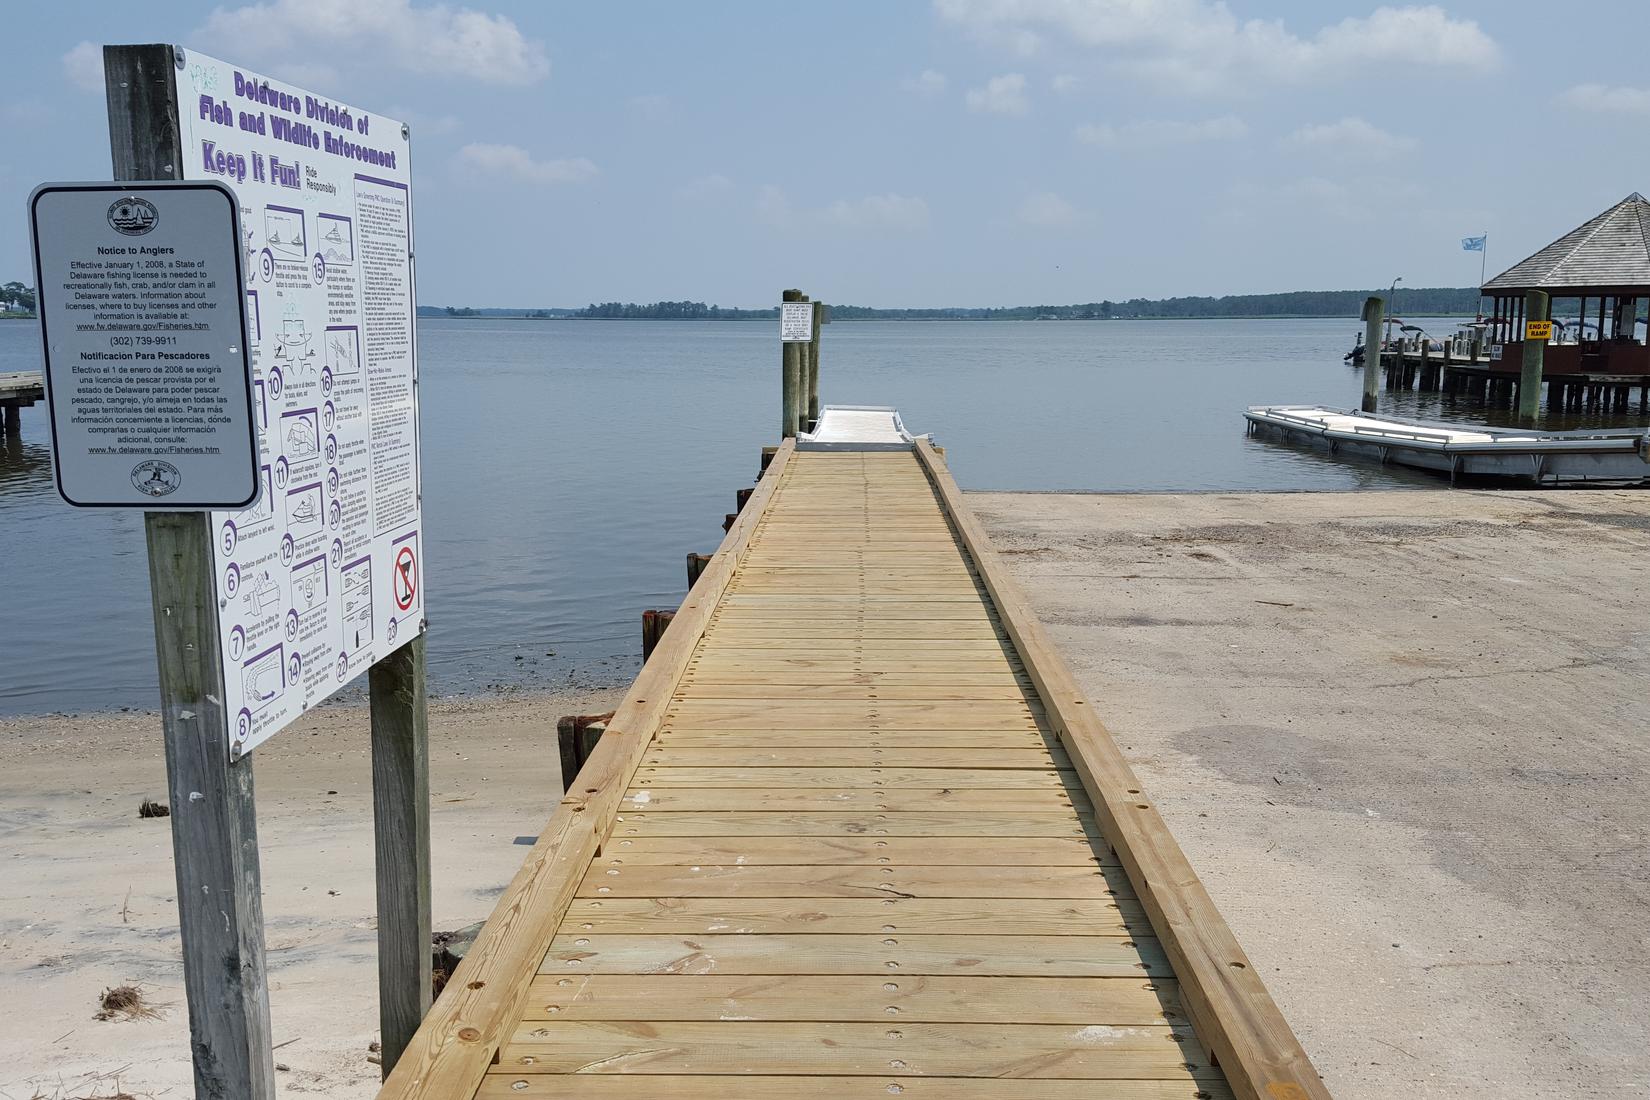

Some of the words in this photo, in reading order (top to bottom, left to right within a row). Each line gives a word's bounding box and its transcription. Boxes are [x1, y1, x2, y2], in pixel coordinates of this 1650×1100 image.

[234, 70, 301, 114] Delaware
[306, 95, 353, 131] Division
[357, 115, 369, 136] of
[200, 94, 234, 127] Fish
[239, 112, 265, 136] and
[270, 114, 320, 150] Wildlife
[324, 130, 396, 170] Enforcement
[201, 139, 247, 184] Keep
[251, 151, 265, 183] It
[269, 155, 301, 190] Fun!
[305, 166, 317, 178] Ride
[306, 178, 336, 195] Responsibly
[98, 247, 126, 255] Notice
[140, 246, 174, 256] Anglers
[71, 261, 102, 269] Effective
[104, 262, 134, 270] January
[175, 260, 195, 268] State
[197, 260, 204, 268] of
[264, 259, 269, 276] 9
[314, 263, 322, 279] 15
[107, 271, 131, 280] fishing
[63, 283, 112, 291] recreationally
[75, 292, 110, 300] Delaware
[133, 303, 147, 311] buy
[110, 337, 133, 347] (302)
[136, 337, 176, 345] 739-9911
[135, 352, 156, 360] Para
[158, 352, 210, 360] Pescadores
[72, 366, 101, 374] Efectivo
[163, 376, 192, 384] provista
[268, 377, 279, 394] 10
[321, 376, 330, 392] 16
[71, 397, 104, 405] pescado,
[142, 396, 154, 405] y/o
[207, 405, 223, 413] más
[71, 414, 114, 423] información
[171, 416, 206, 424] licencias,
[208, 415, 231, 423] dónde
[324, 411, 332, 427] 17
[173, 425, 216, 433] información
[324, 444, 334, 460] 18
[276, 467, 284, 484] 11
[328, 477, 336, 493] 19
[331, 509, 338, 525] 20
[224, 533, 232, 551] 5
[281, 542, 290, 560] 12
[331, 547, 340, 563] 21
[228, 573, 235, 592] 6
[286, 619, 295, 637] 13
[389, 625, 395, 642] 23
[233, 636, 239, 655] 7
[288, 662, 298, 681] 14
[338, 660, 346, 678] 22
[240, 719, 246, 736] 8
